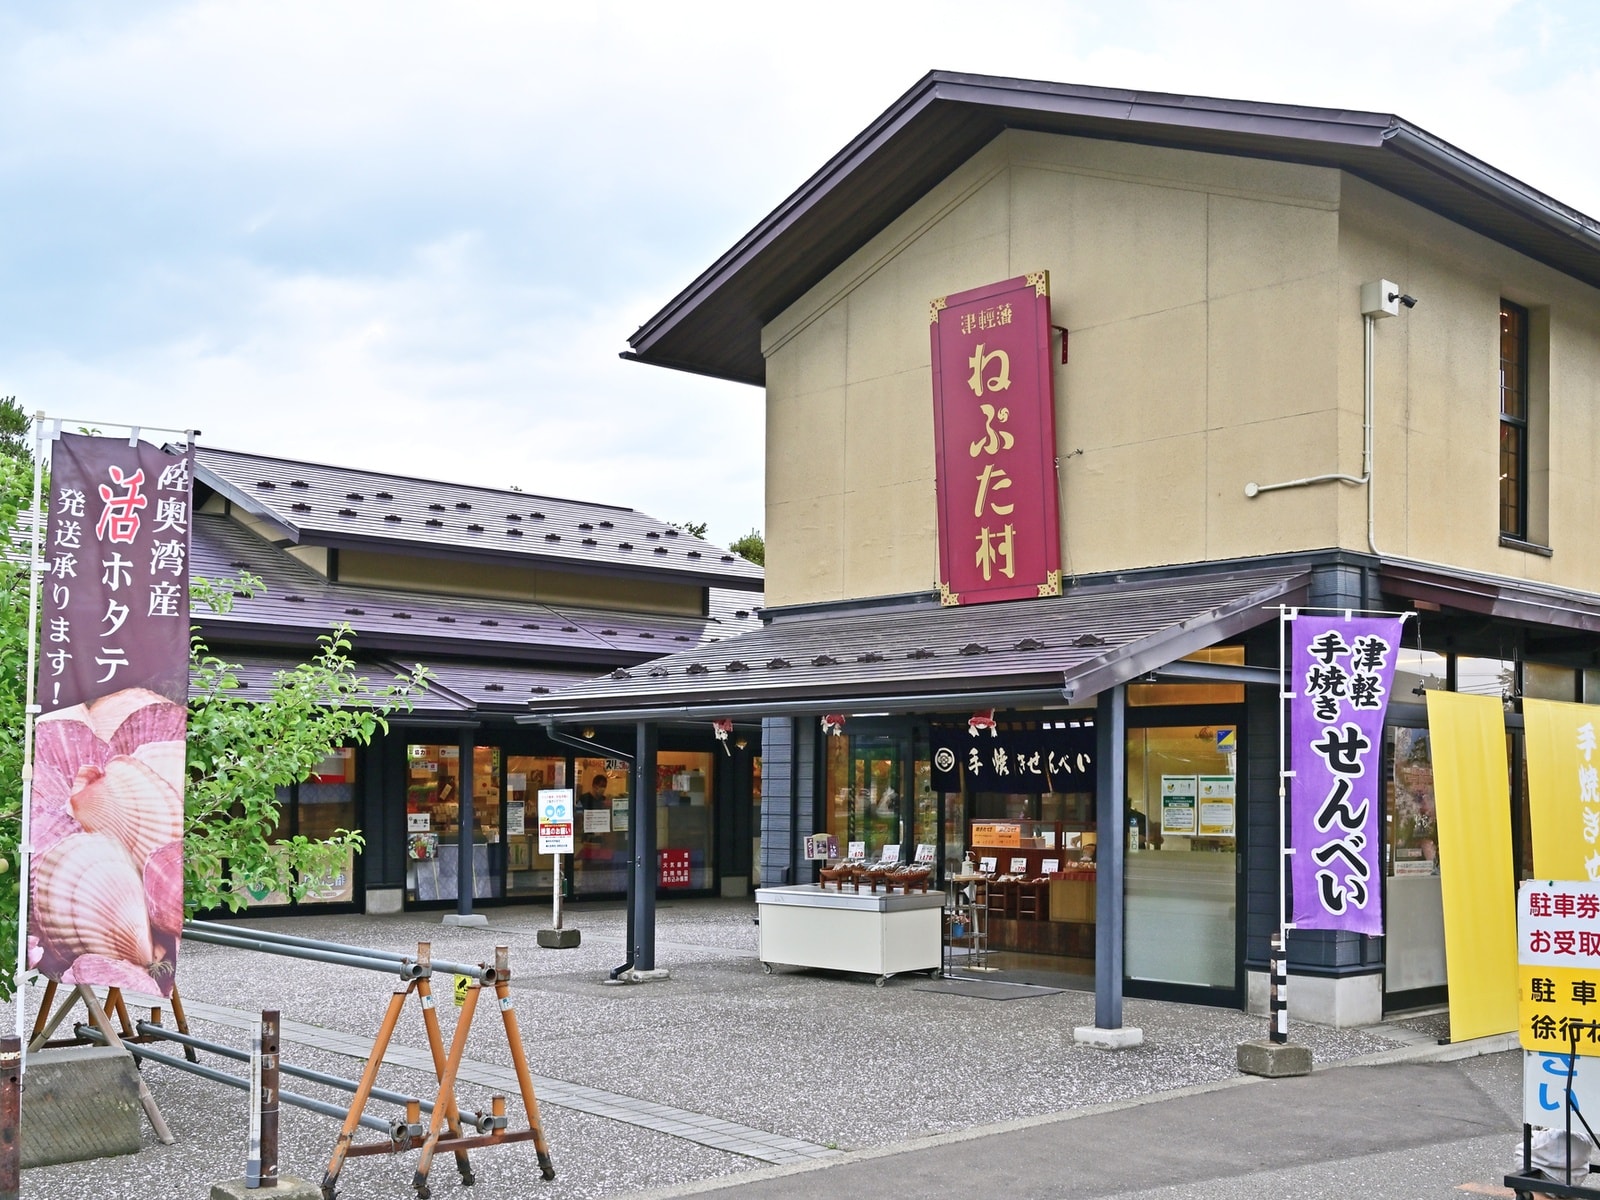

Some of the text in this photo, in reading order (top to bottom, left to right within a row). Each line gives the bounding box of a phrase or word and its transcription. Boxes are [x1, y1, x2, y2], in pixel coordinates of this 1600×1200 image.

[147, 458, 189, 617] 陸奥湾産
[967, 342, 1017, 582] ねぶた村
[46, 488, 87, 705] 発送承ります!
[95, 465, 147, 684] 活ホタテ
[1307, 632, 1349, 721] 手焼き
[1350, 637, 1388, 708] 津軽
[1312, 725, 1370, 912] せんべい
[1529, 892, 1600, 919] 駐車券
[1530, 929, 1600, 956] お受取
